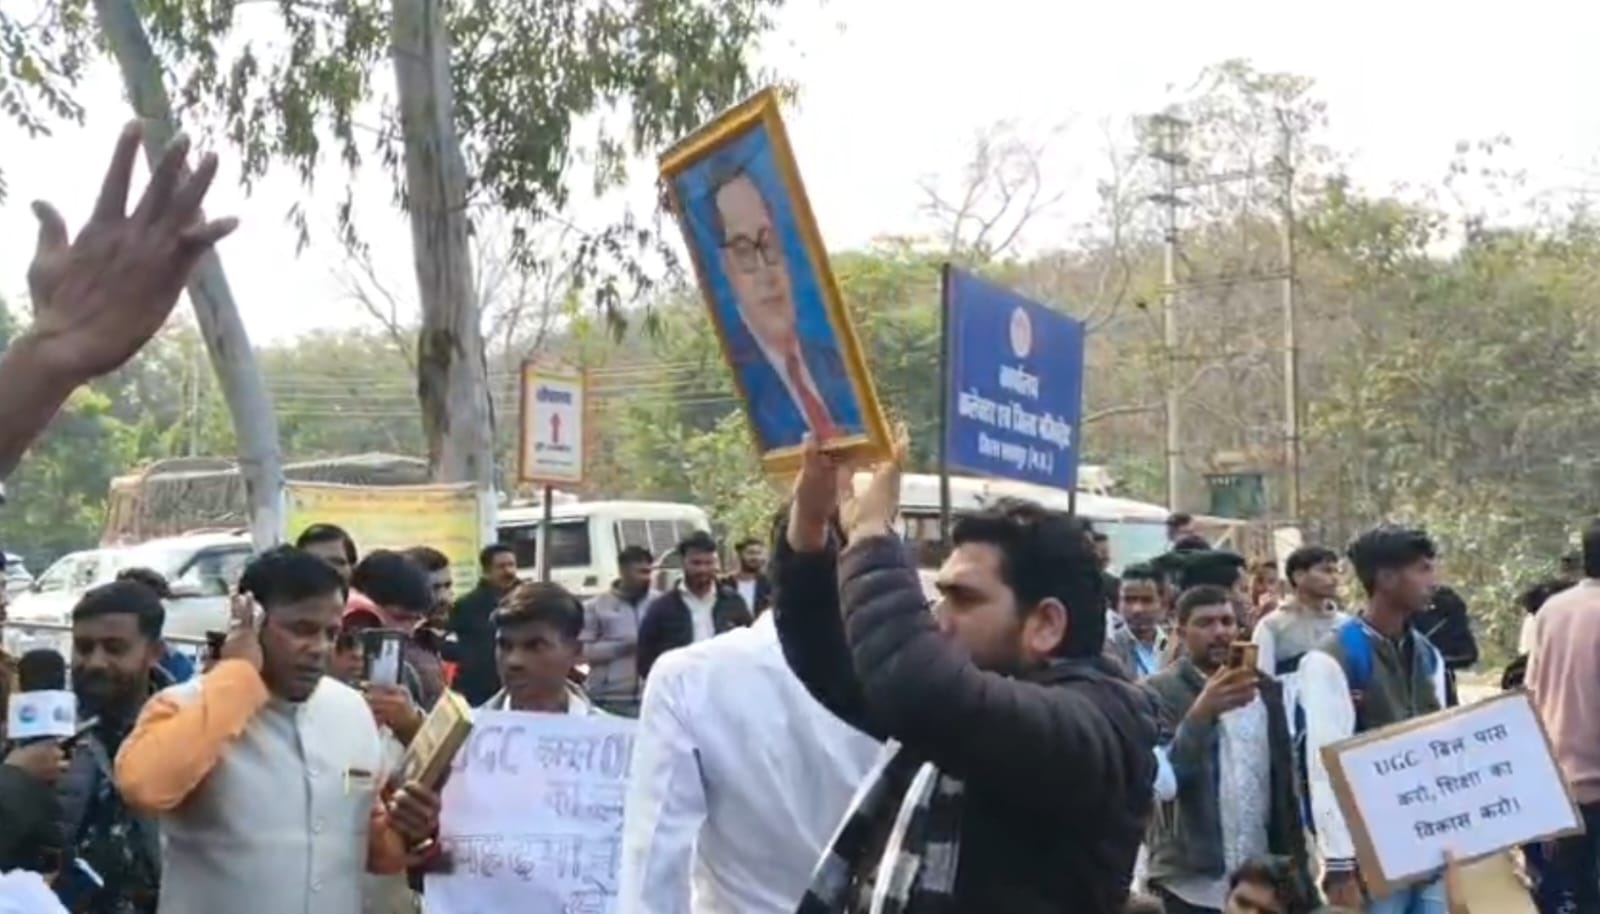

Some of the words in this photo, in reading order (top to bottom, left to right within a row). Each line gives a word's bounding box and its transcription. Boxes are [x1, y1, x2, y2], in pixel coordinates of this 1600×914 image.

[1373, 751, 1419, 776] UGC
[1428, 736, 1466, 760] बिल
[1473, 723, 1508, 744] पास
[1489, 761, 1513, 778] का
[1413, 811, 1472, 840] विकास
